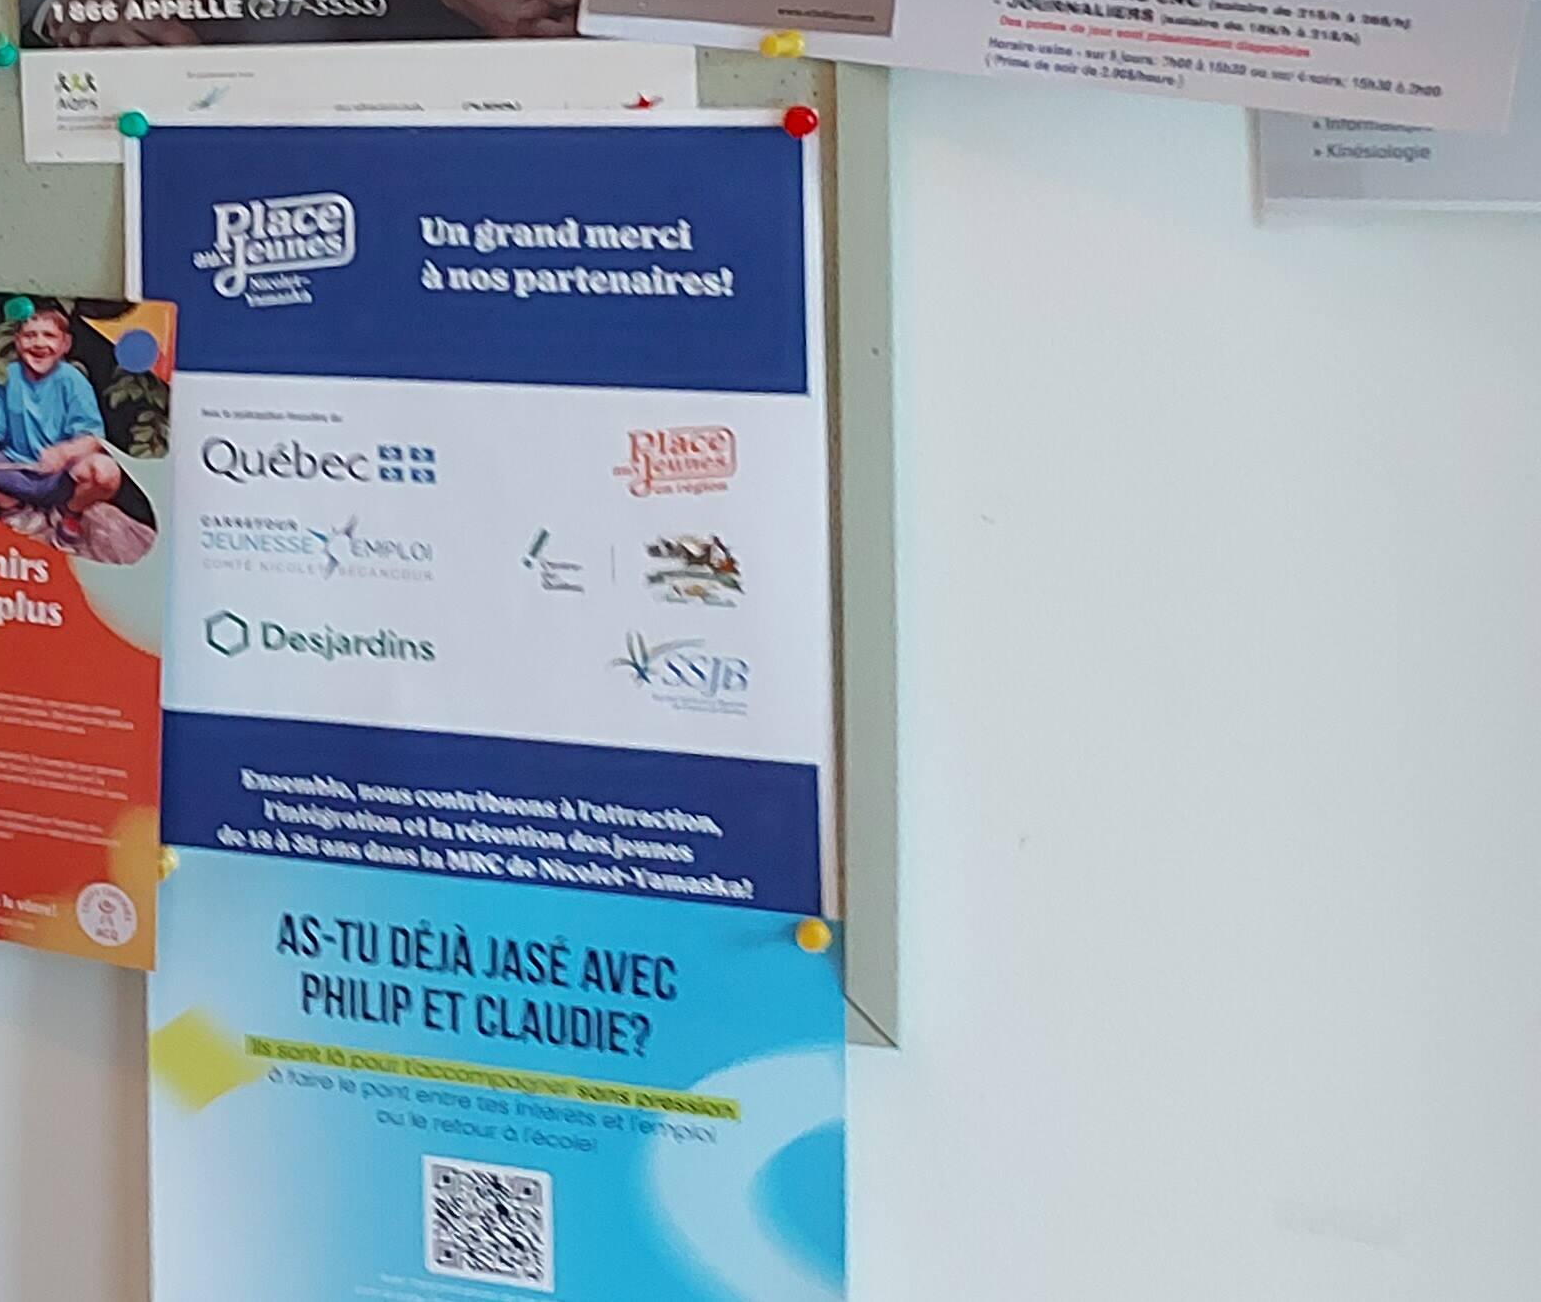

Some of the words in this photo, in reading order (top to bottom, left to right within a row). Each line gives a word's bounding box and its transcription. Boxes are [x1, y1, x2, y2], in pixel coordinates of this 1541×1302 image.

[52, 2, 64, 24] 1
[68, 0, 118, 23] 866
[1326, 143, 1432, 163] Kinésiologie
[213, 200, 343, 251] Place
[420, 216, 470, 246] Un
[473, 217, 582, 253] grand
[583, 218, 693, 250] merci
[213, 233, 343, 298] Jeunes
[421, 258, 444, 290] à
[447, 266, 510, 291] nos
[513, 264, 734, 298] partenaires!
[202, 436, 371, 484] Québec
[201, 530, 315, 555] JEUNESSE
[350, 538, 433, 562] EMPLOI
[261, 621, 437, 663] Desjardins
[356, 783, 415, 806] nous
[414, 789, 558, 819] contribuons
[276, 912, 380, 966] AS-TU
[389, 919, 476, 977] DÉJÀ
[482, 935, 572, 988] JASÉ
[580, 947, 679, 1001] AVEC
[301, 971, 412, 1025] PHILIP
[422, 986, 465, 1033] ET
[475, 993, 651, 1058] CLAUDIE?
[276, 1044, 322, 1062] sont
[350, 1053, 400, 1071] pour
[576, 1083, 632, 1106] sans
[635, 1092, 738, 1120] pression
[376, 1108, 406, 1127] ou
[409, 1110, 428, 1129] le
[432, 1114, 499, 1139] retour
[503, 1123, 518, 1142] à
